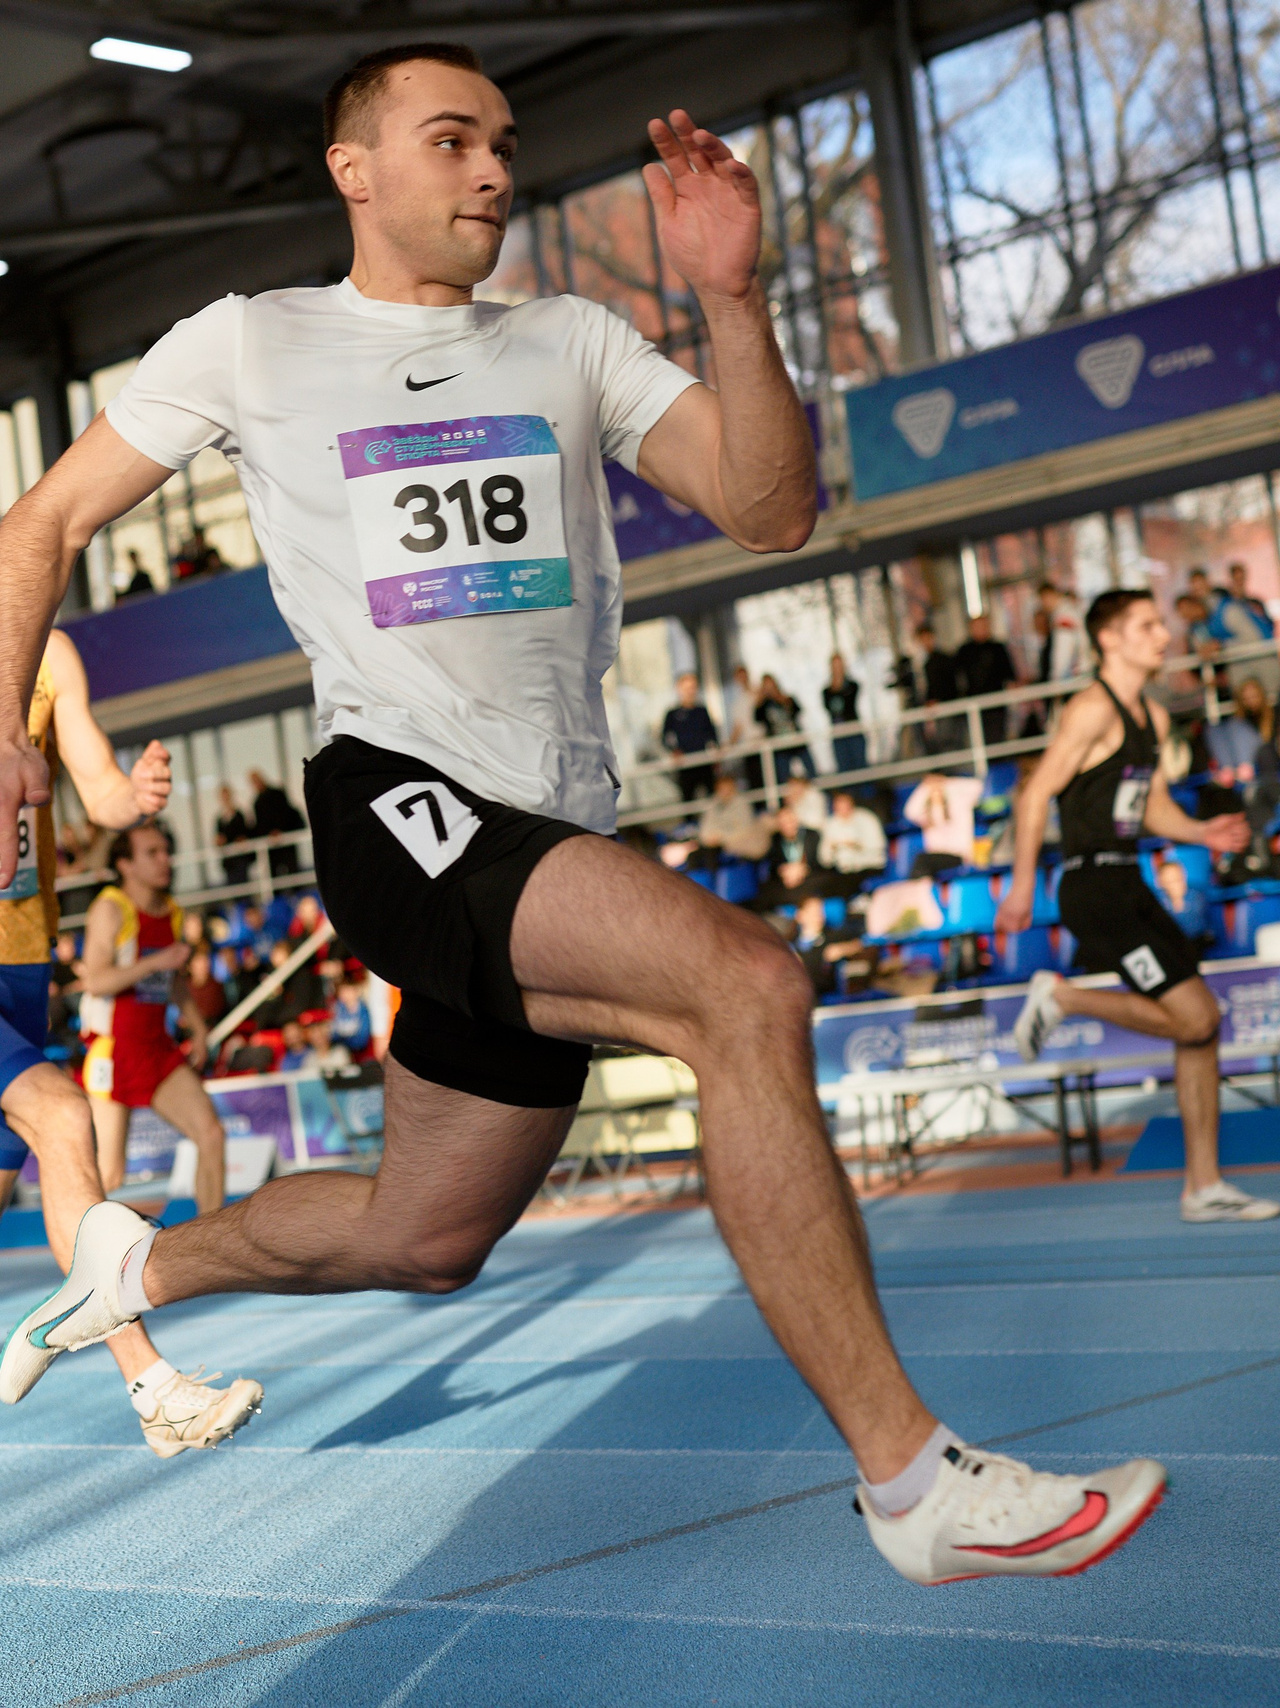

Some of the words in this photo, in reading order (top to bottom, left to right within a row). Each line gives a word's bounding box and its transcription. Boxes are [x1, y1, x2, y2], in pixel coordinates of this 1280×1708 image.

[441, 428, 486, 441] 2025
[395, 450, 440, 461] СПОРТА
[393, 474, 528, 553] 318
[395, 789, 450, 847] 7
[1132, 957, 1155, 983] 2
